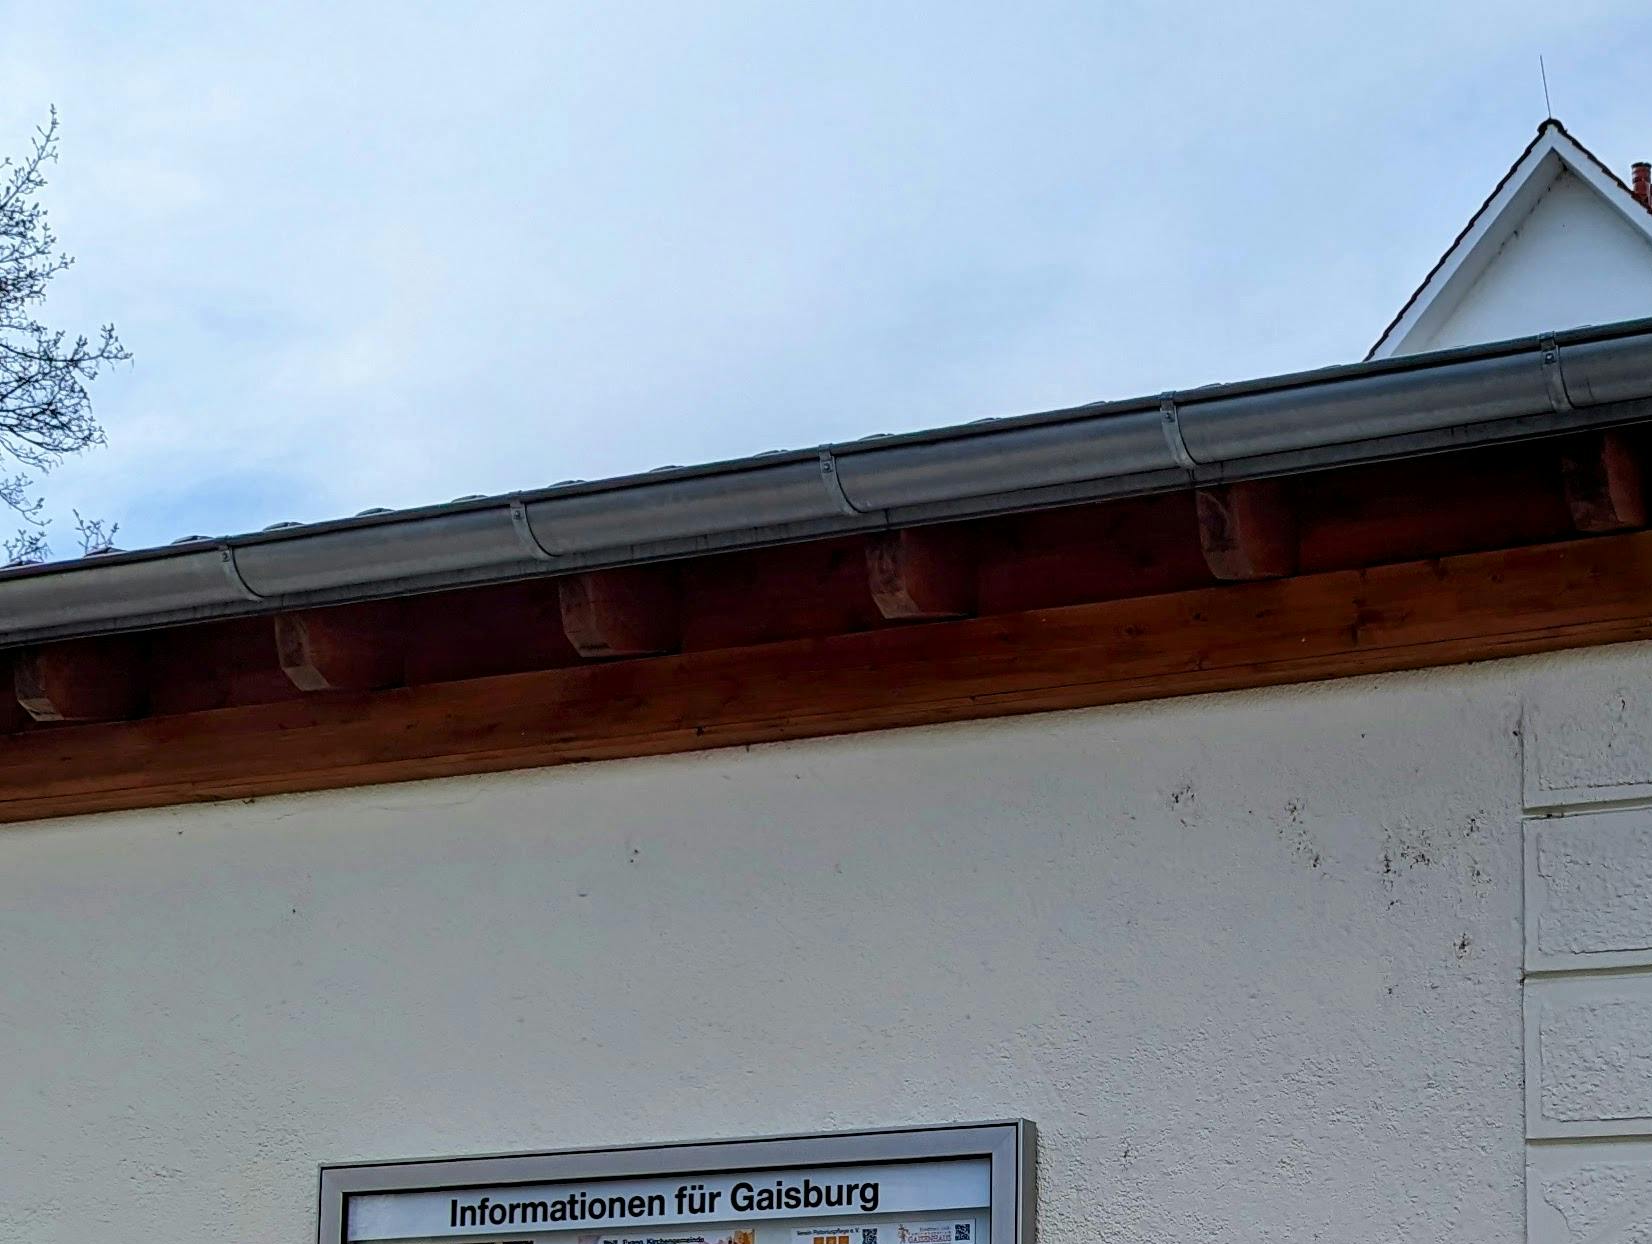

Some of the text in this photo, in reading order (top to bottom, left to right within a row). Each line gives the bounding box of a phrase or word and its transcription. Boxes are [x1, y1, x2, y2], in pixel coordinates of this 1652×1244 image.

[450, 1179, 879, 1227] Informationen für Gaisburg
